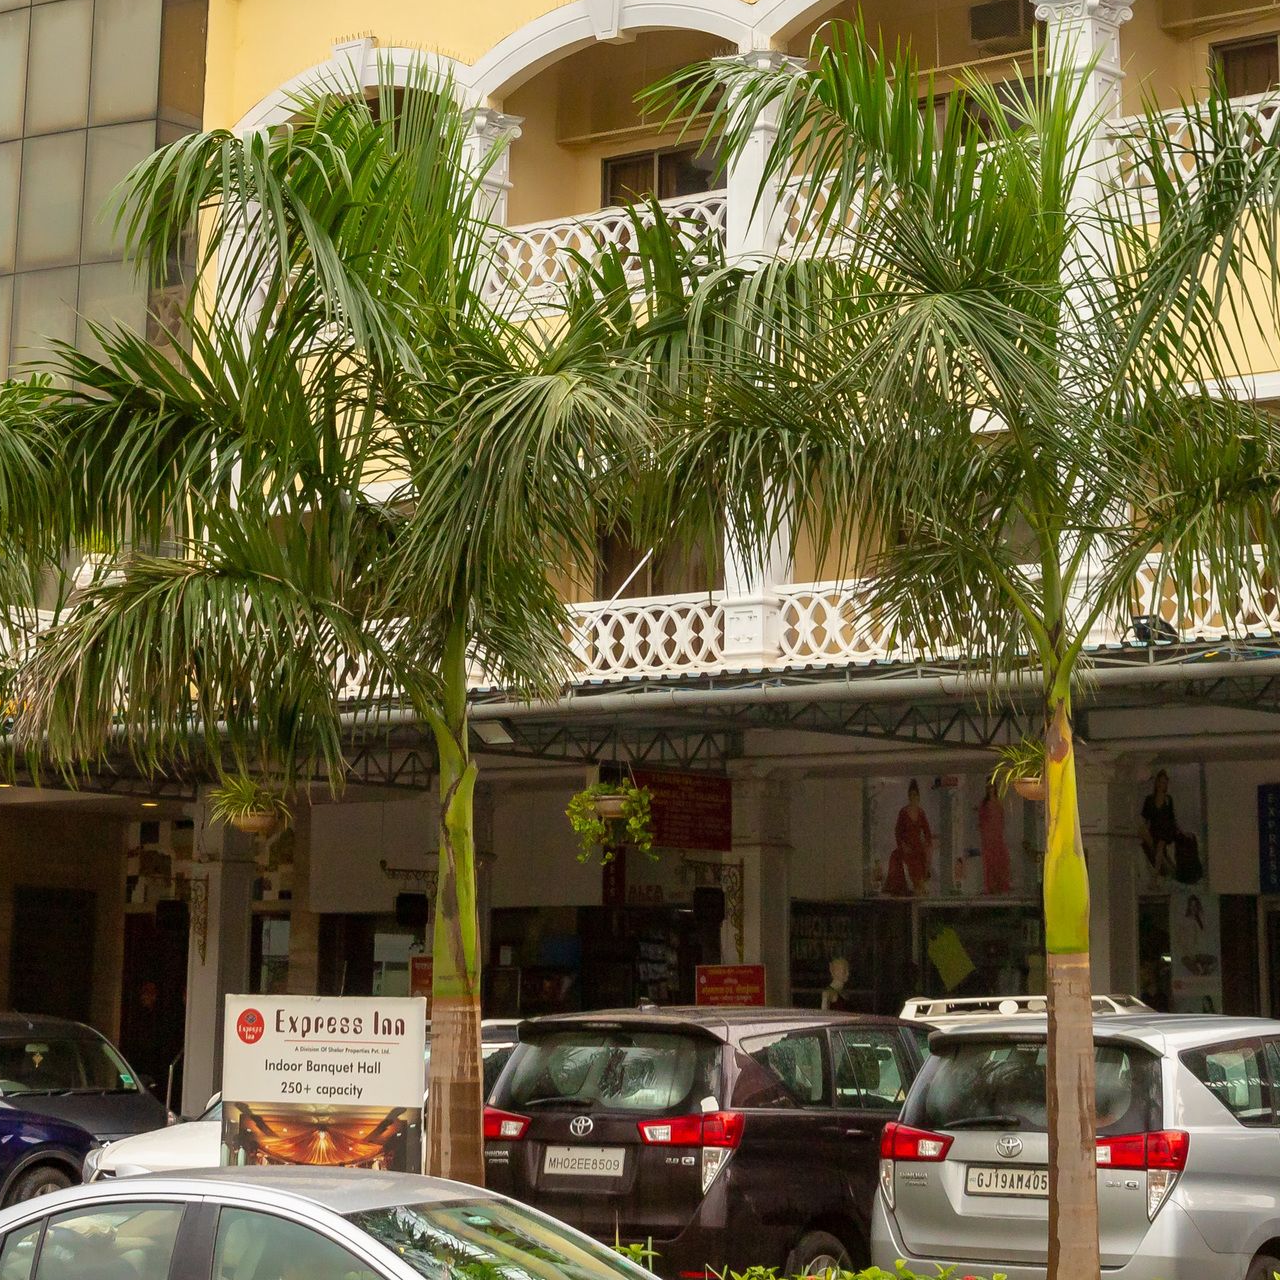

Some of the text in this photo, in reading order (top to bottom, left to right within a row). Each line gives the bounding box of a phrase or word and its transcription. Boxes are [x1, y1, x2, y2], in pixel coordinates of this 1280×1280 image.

[275, 1009, 405, 1038] Express Inn
[265, 1059, 381, 1076] Indoor Banquet Hall
[281, 1082, 363, 1099] 250+ capacity
[548, 1157, 620, 1170] MH02EE8509
[977, 1172, 1048, 1190] GJ19AM405
